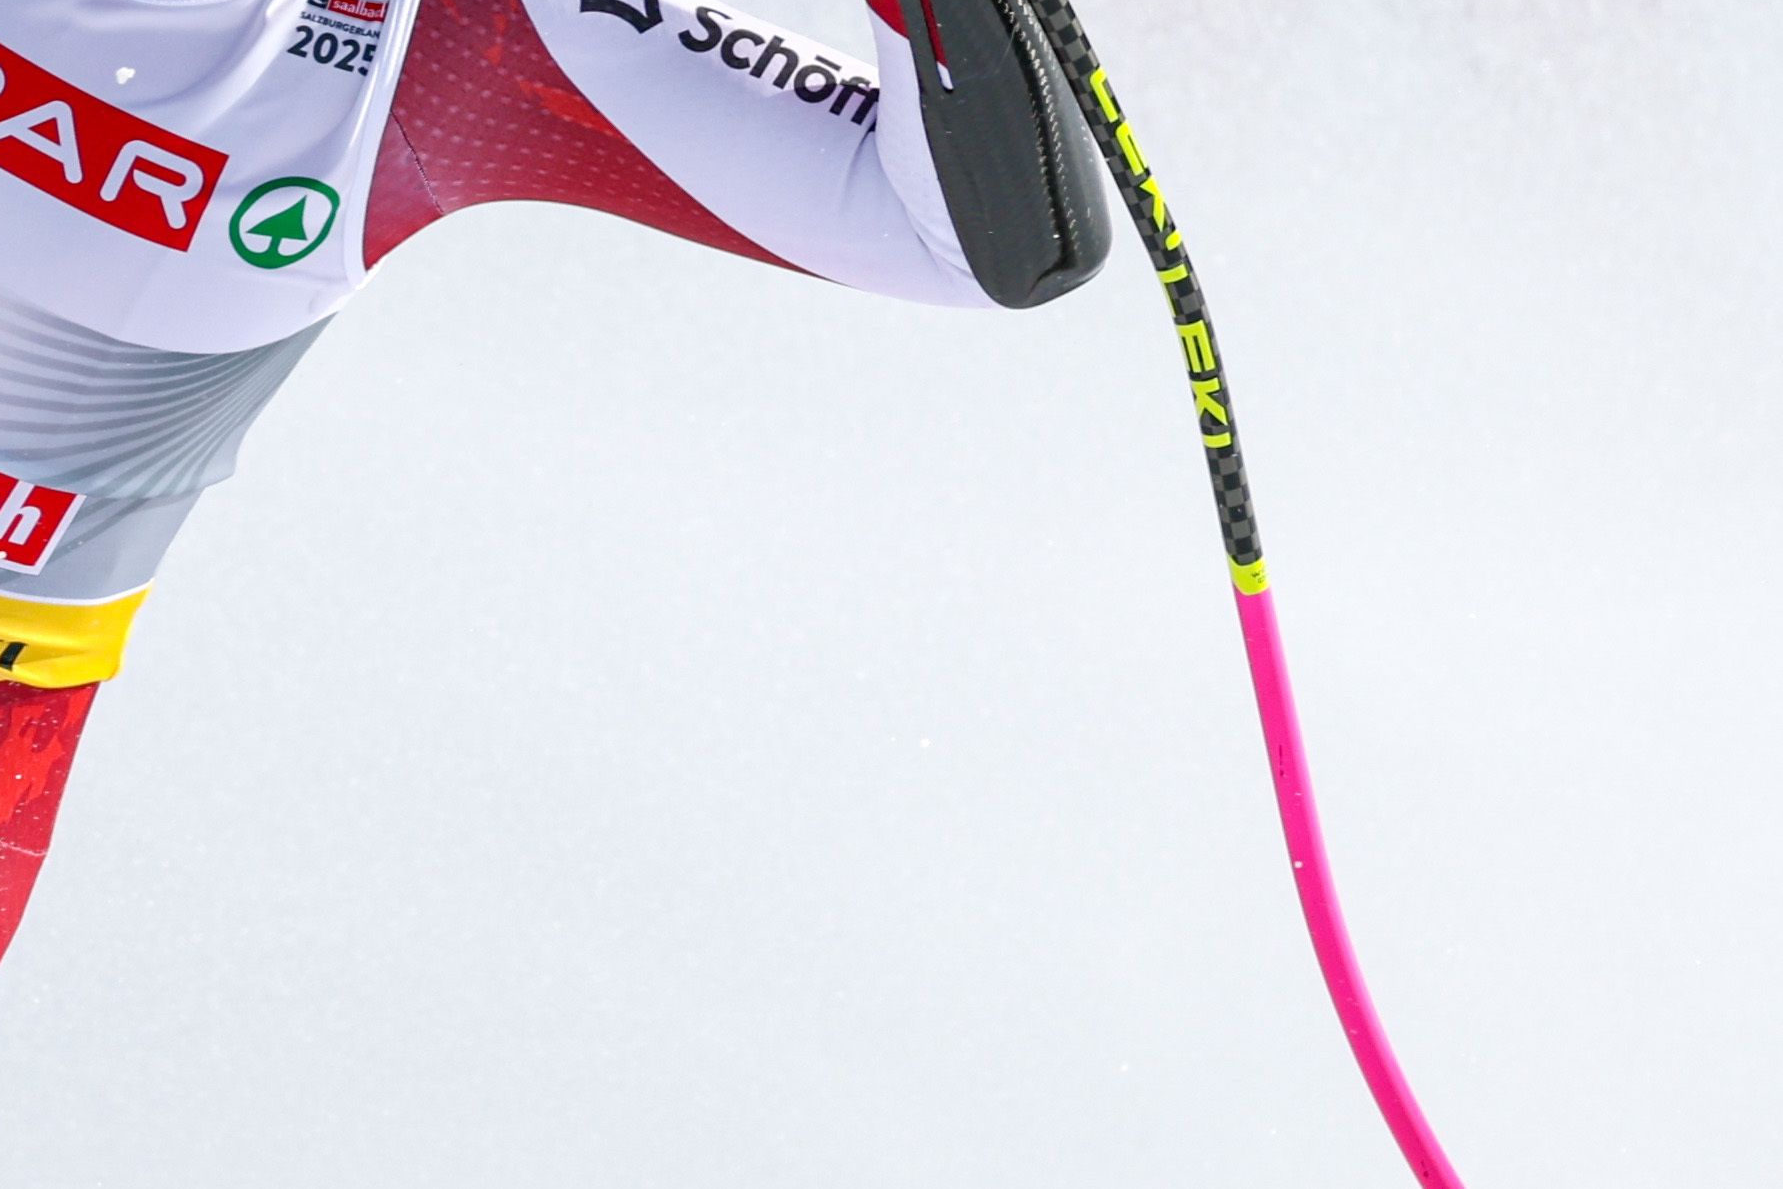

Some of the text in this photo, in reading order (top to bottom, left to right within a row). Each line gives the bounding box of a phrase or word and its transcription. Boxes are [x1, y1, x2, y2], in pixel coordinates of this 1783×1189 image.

[286, 25, 377, 76] 2025
[300, 11, 380, 39] SALZBURGERLAN
[1157, 264, 1232, 449] LEKI
